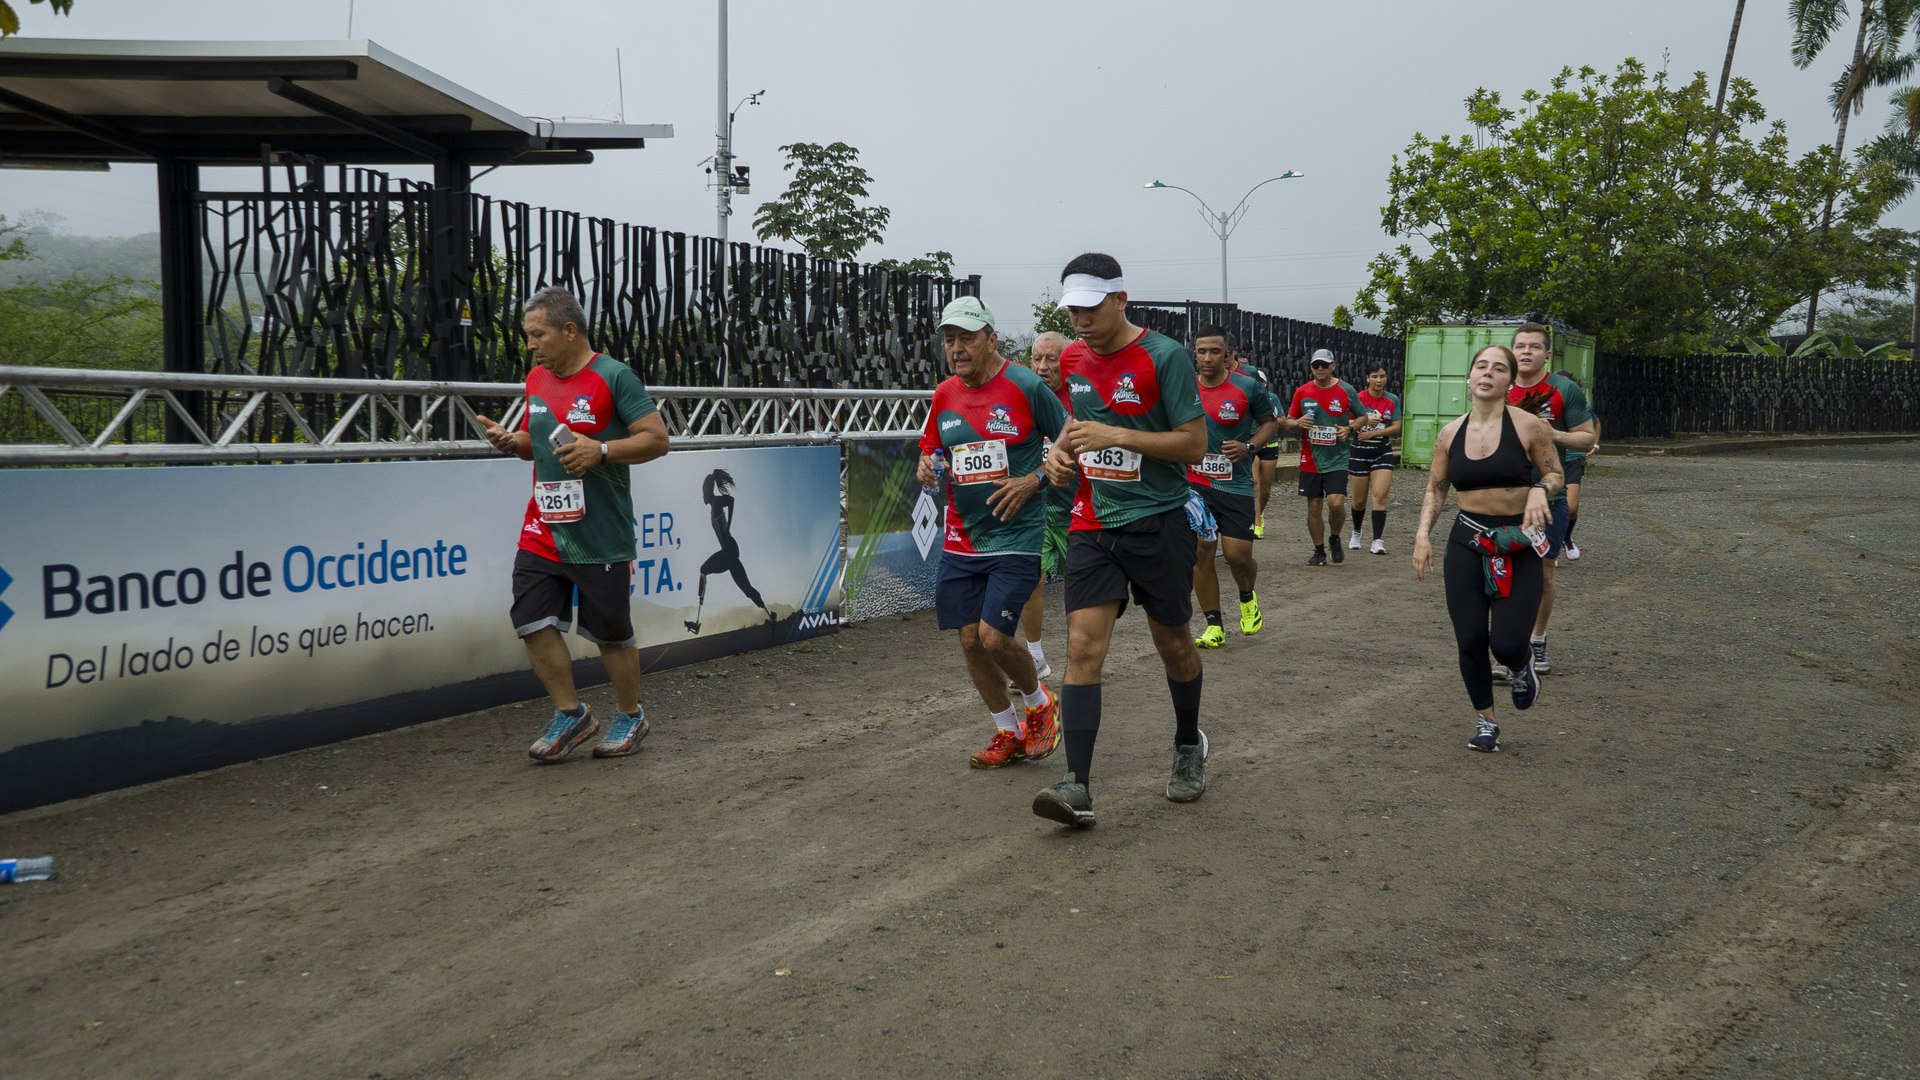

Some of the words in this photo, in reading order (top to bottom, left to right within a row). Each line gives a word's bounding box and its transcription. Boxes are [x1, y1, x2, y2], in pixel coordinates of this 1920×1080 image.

[1312, 431, 1332, 440] 1150
[964, 454, 992, 472] 508
[1093, 449, 1124, 467] 363
[540, 493, 571, 510] 1261
[43, 563, 207, 620] Banco
[219, 550, 272, 601] de
[282, 539, 468, 593] Occidente
[798, 611, 838, 631] AVAL
[46, 645, 108, 690] Del
[119, 636, 194, 679] lado
[203, 629, 241, 665] de
[250, 625, 290, 658] los
[299, 623, 348, 658] que
[355, 612, 435, 642] hacen.
